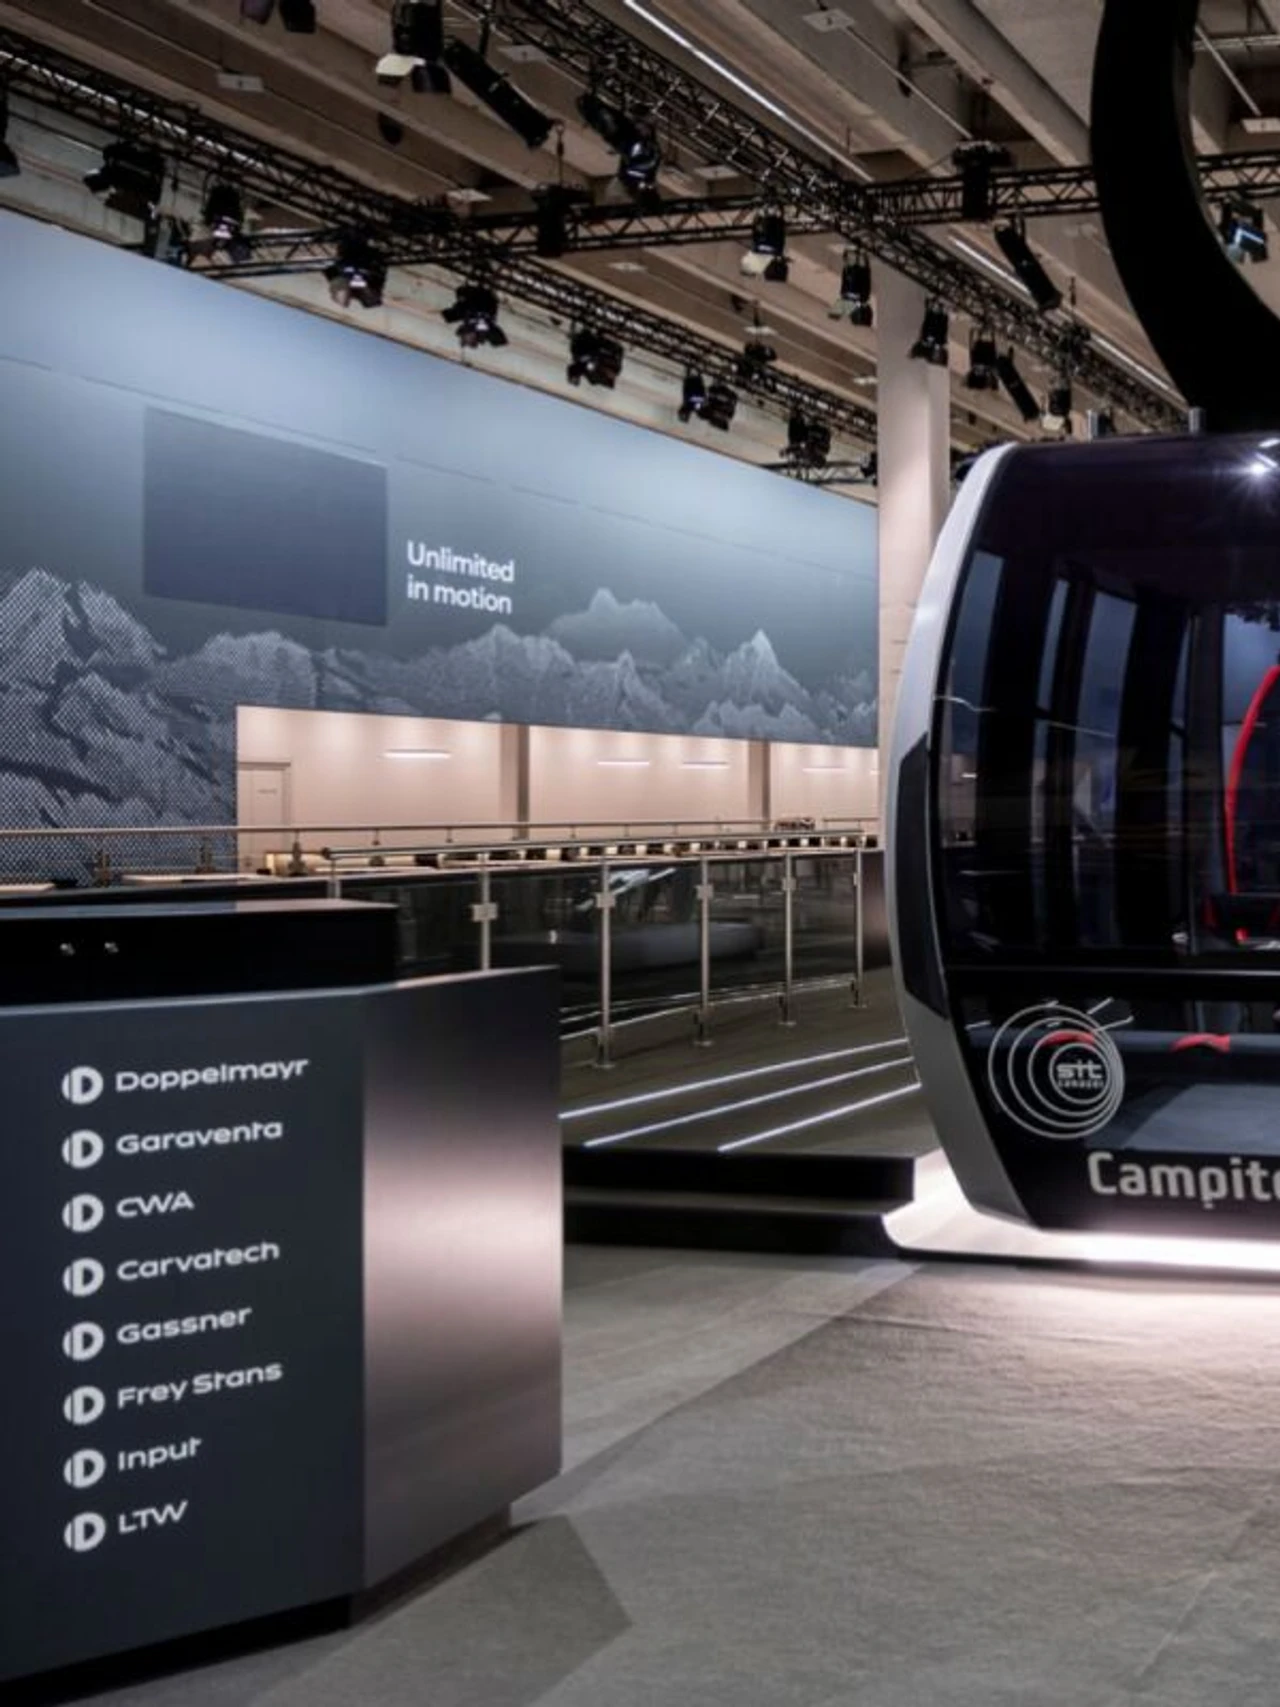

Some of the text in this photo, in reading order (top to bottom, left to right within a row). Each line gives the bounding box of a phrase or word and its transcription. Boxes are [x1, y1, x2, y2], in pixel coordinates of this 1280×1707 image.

[407, 539, 515, 582] Unlimited
[407, 573, 512, 614] in motion
[115, 1059, 309, 1092] Doppelmayr
[115, 1121, 283, 1155] Garaventa
[116, 1191, 195, 1218] CWA
[116, 1241, 280, 1281] Carvatech
[116, 1307, 252, 1344] Gassner
[117, 1363, 283, 1409] Frey Stans
[118, 1437, 202, 1472] Input
[118, 1501, 188, 1534] LTW
